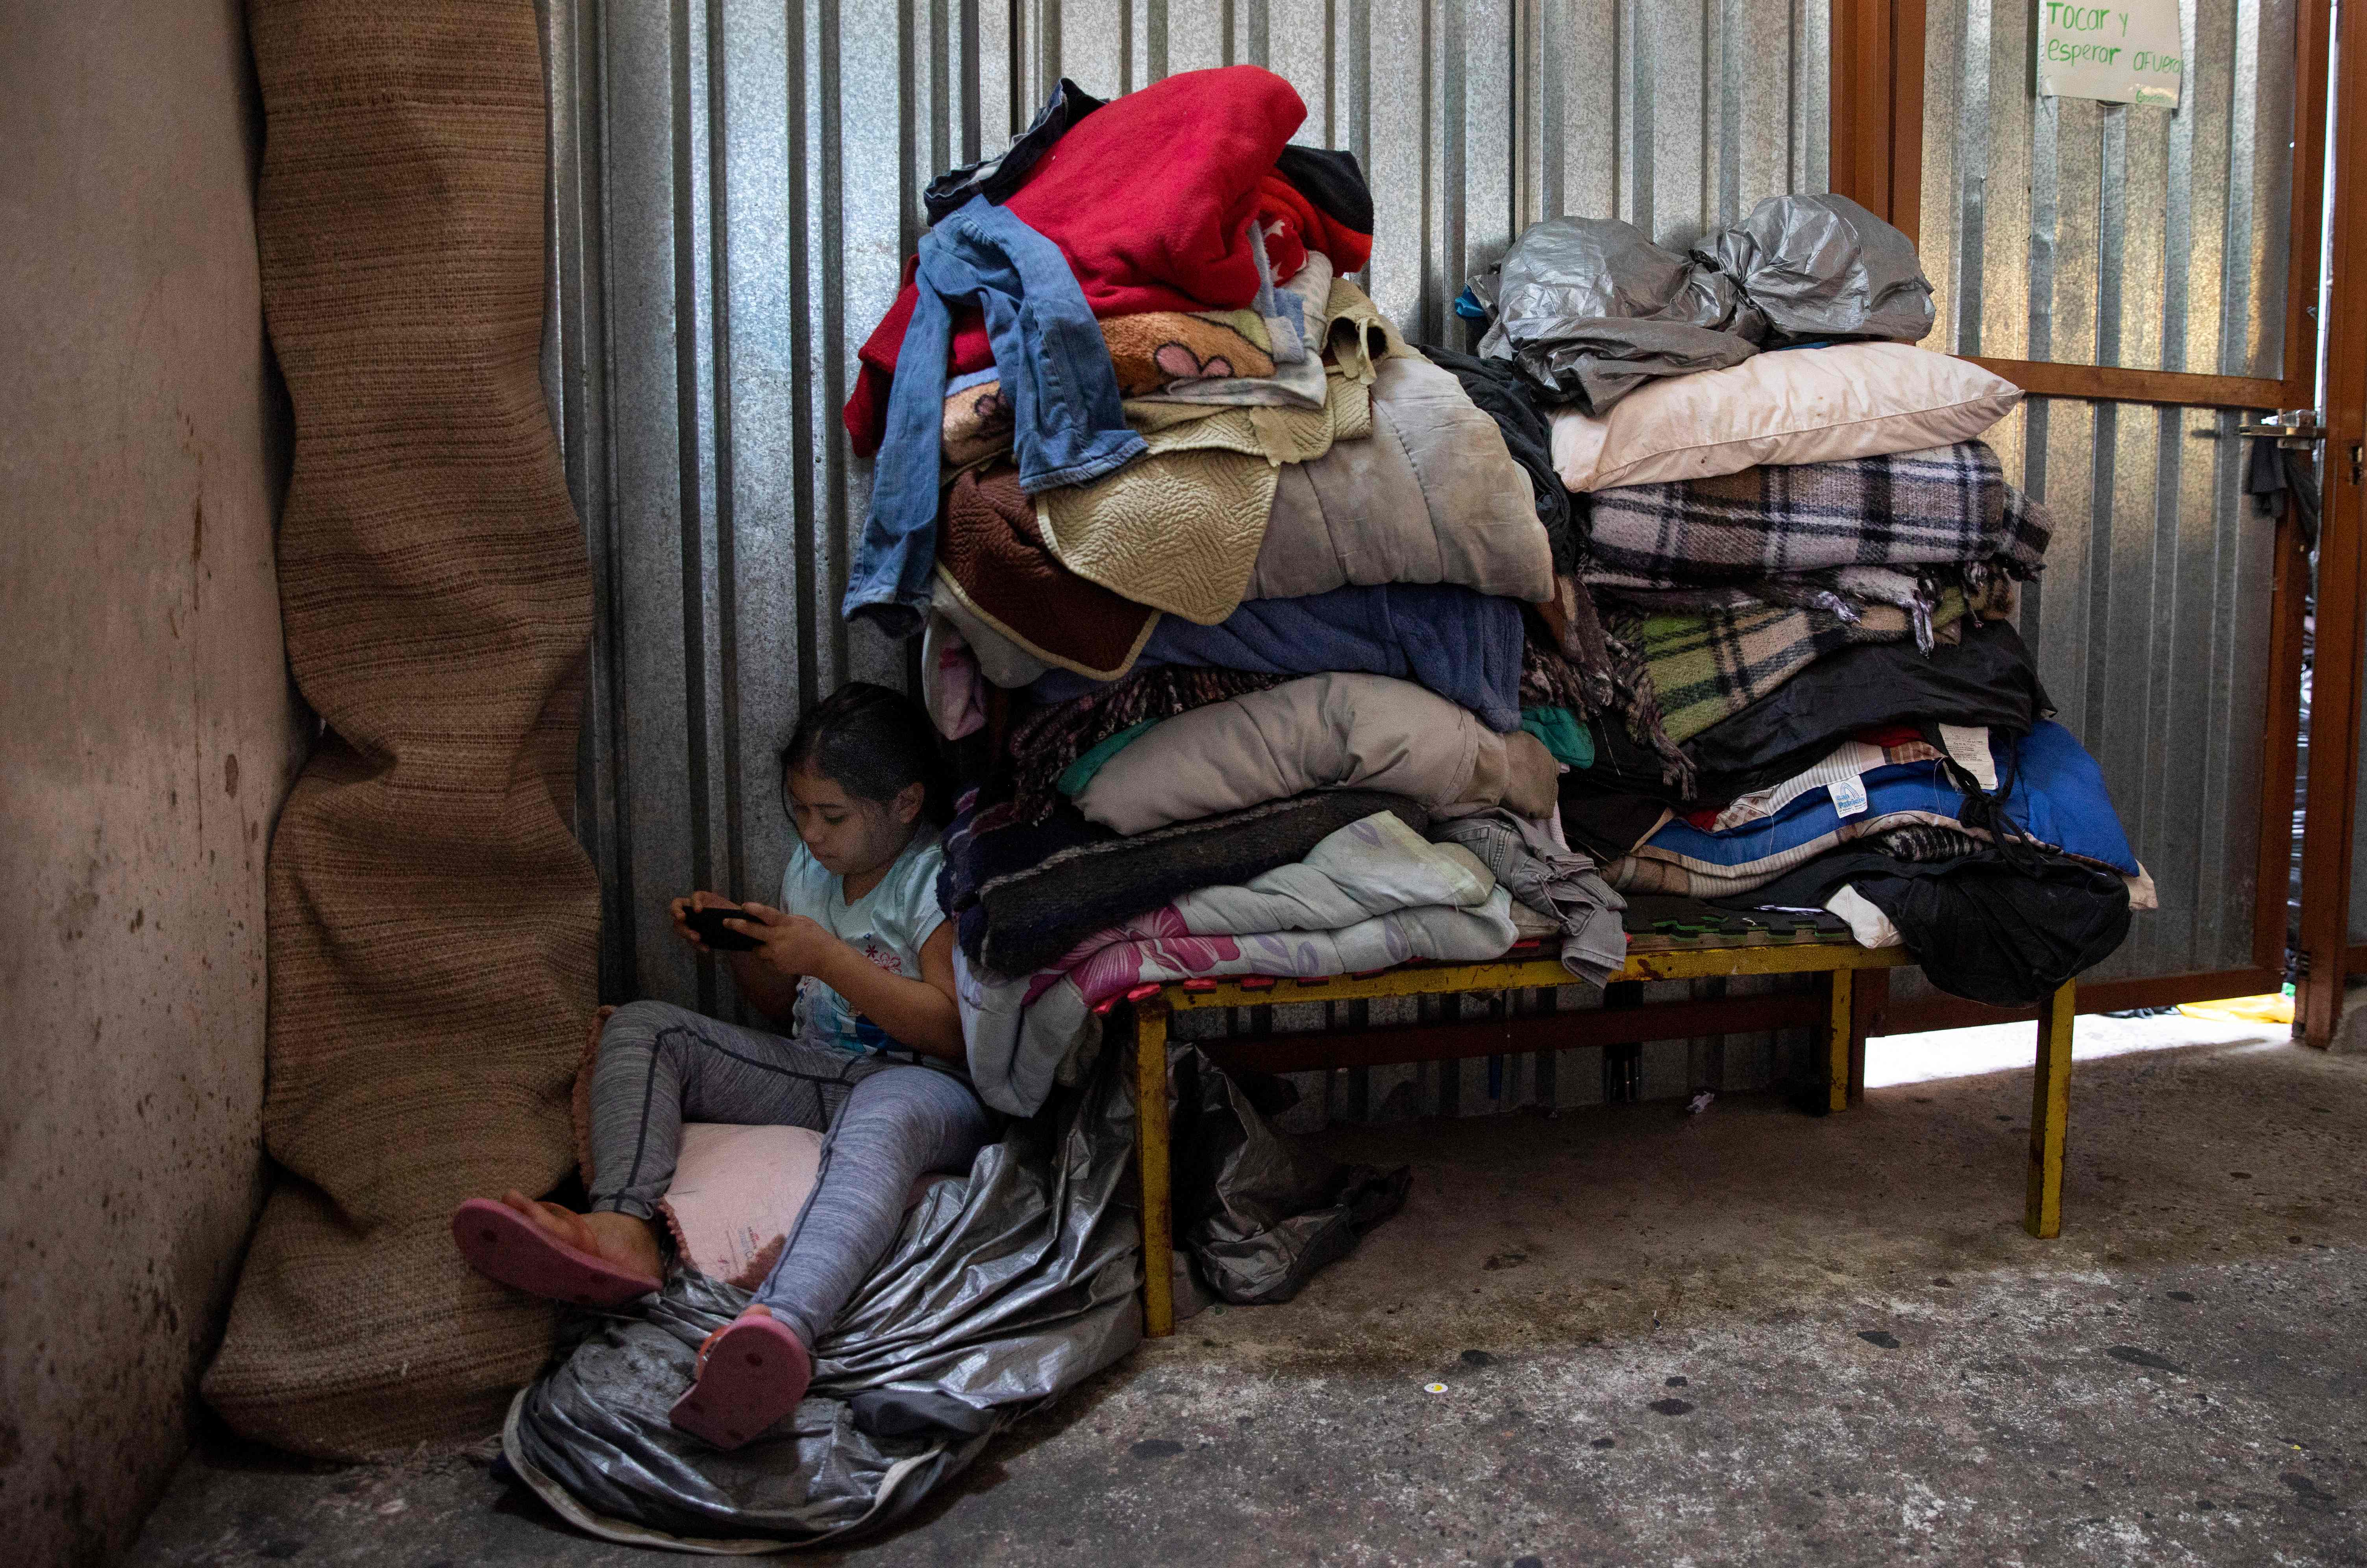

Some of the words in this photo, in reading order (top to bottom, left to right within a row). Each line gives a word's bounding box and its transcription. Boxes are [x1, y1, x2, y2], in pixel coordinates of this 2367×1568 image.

[2046, 2, 2110, 31] Tocar
[2048, 39, 2121, 66] esperar
[1838, 797, 1865, 809] Patricio
